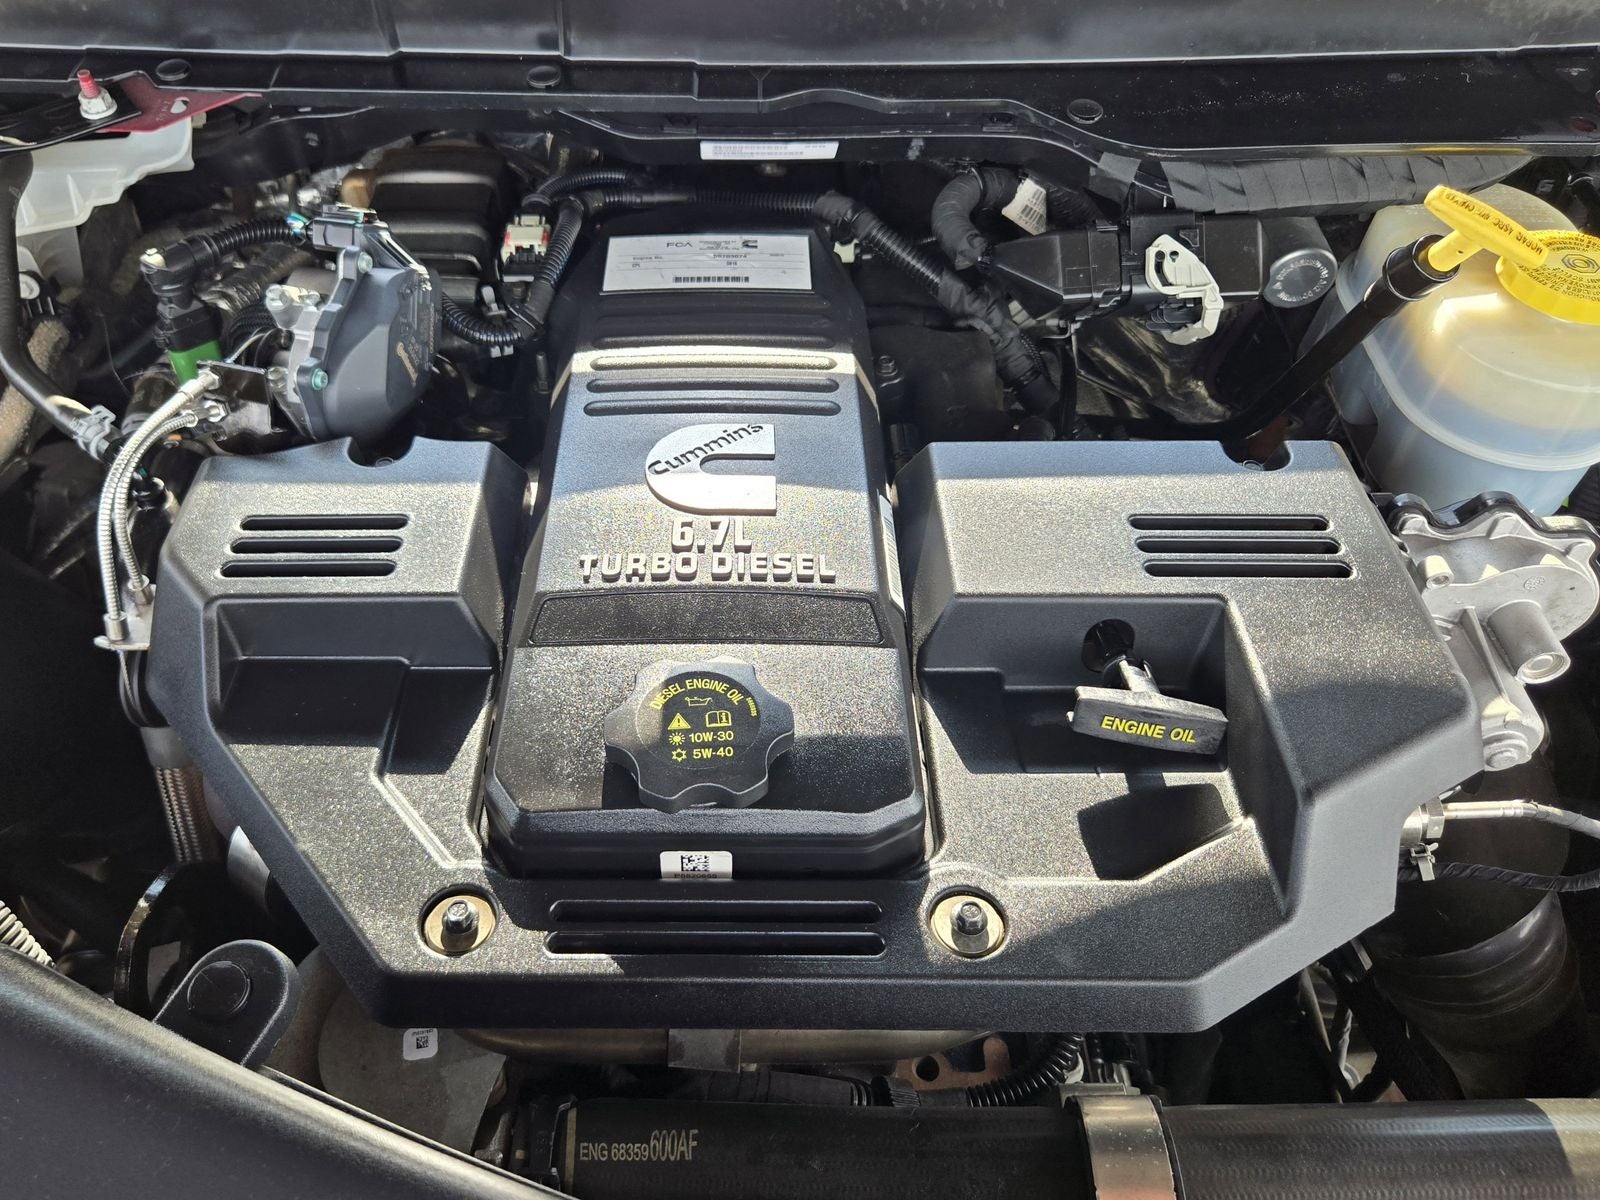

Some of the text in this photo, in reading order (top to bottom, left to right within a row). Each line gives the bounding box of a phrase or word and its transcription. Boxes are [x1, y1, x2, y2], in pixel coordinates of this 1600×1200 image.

[1515, 231, 1543, 256] MOPAR
[671, 517, 753, 552] 6.7L
[580, 552, 836, 583] TURBO DIESEL
[649, 678, 745, 711] DIESEL ENGINE OIL
[688, 730, 734, 743] 10W-30
[1101, 715, 1196, 743] ENGINE OIL
[692, 746, 734, 759] 5W-40
[579, 1142, 608, 1161] ENG
